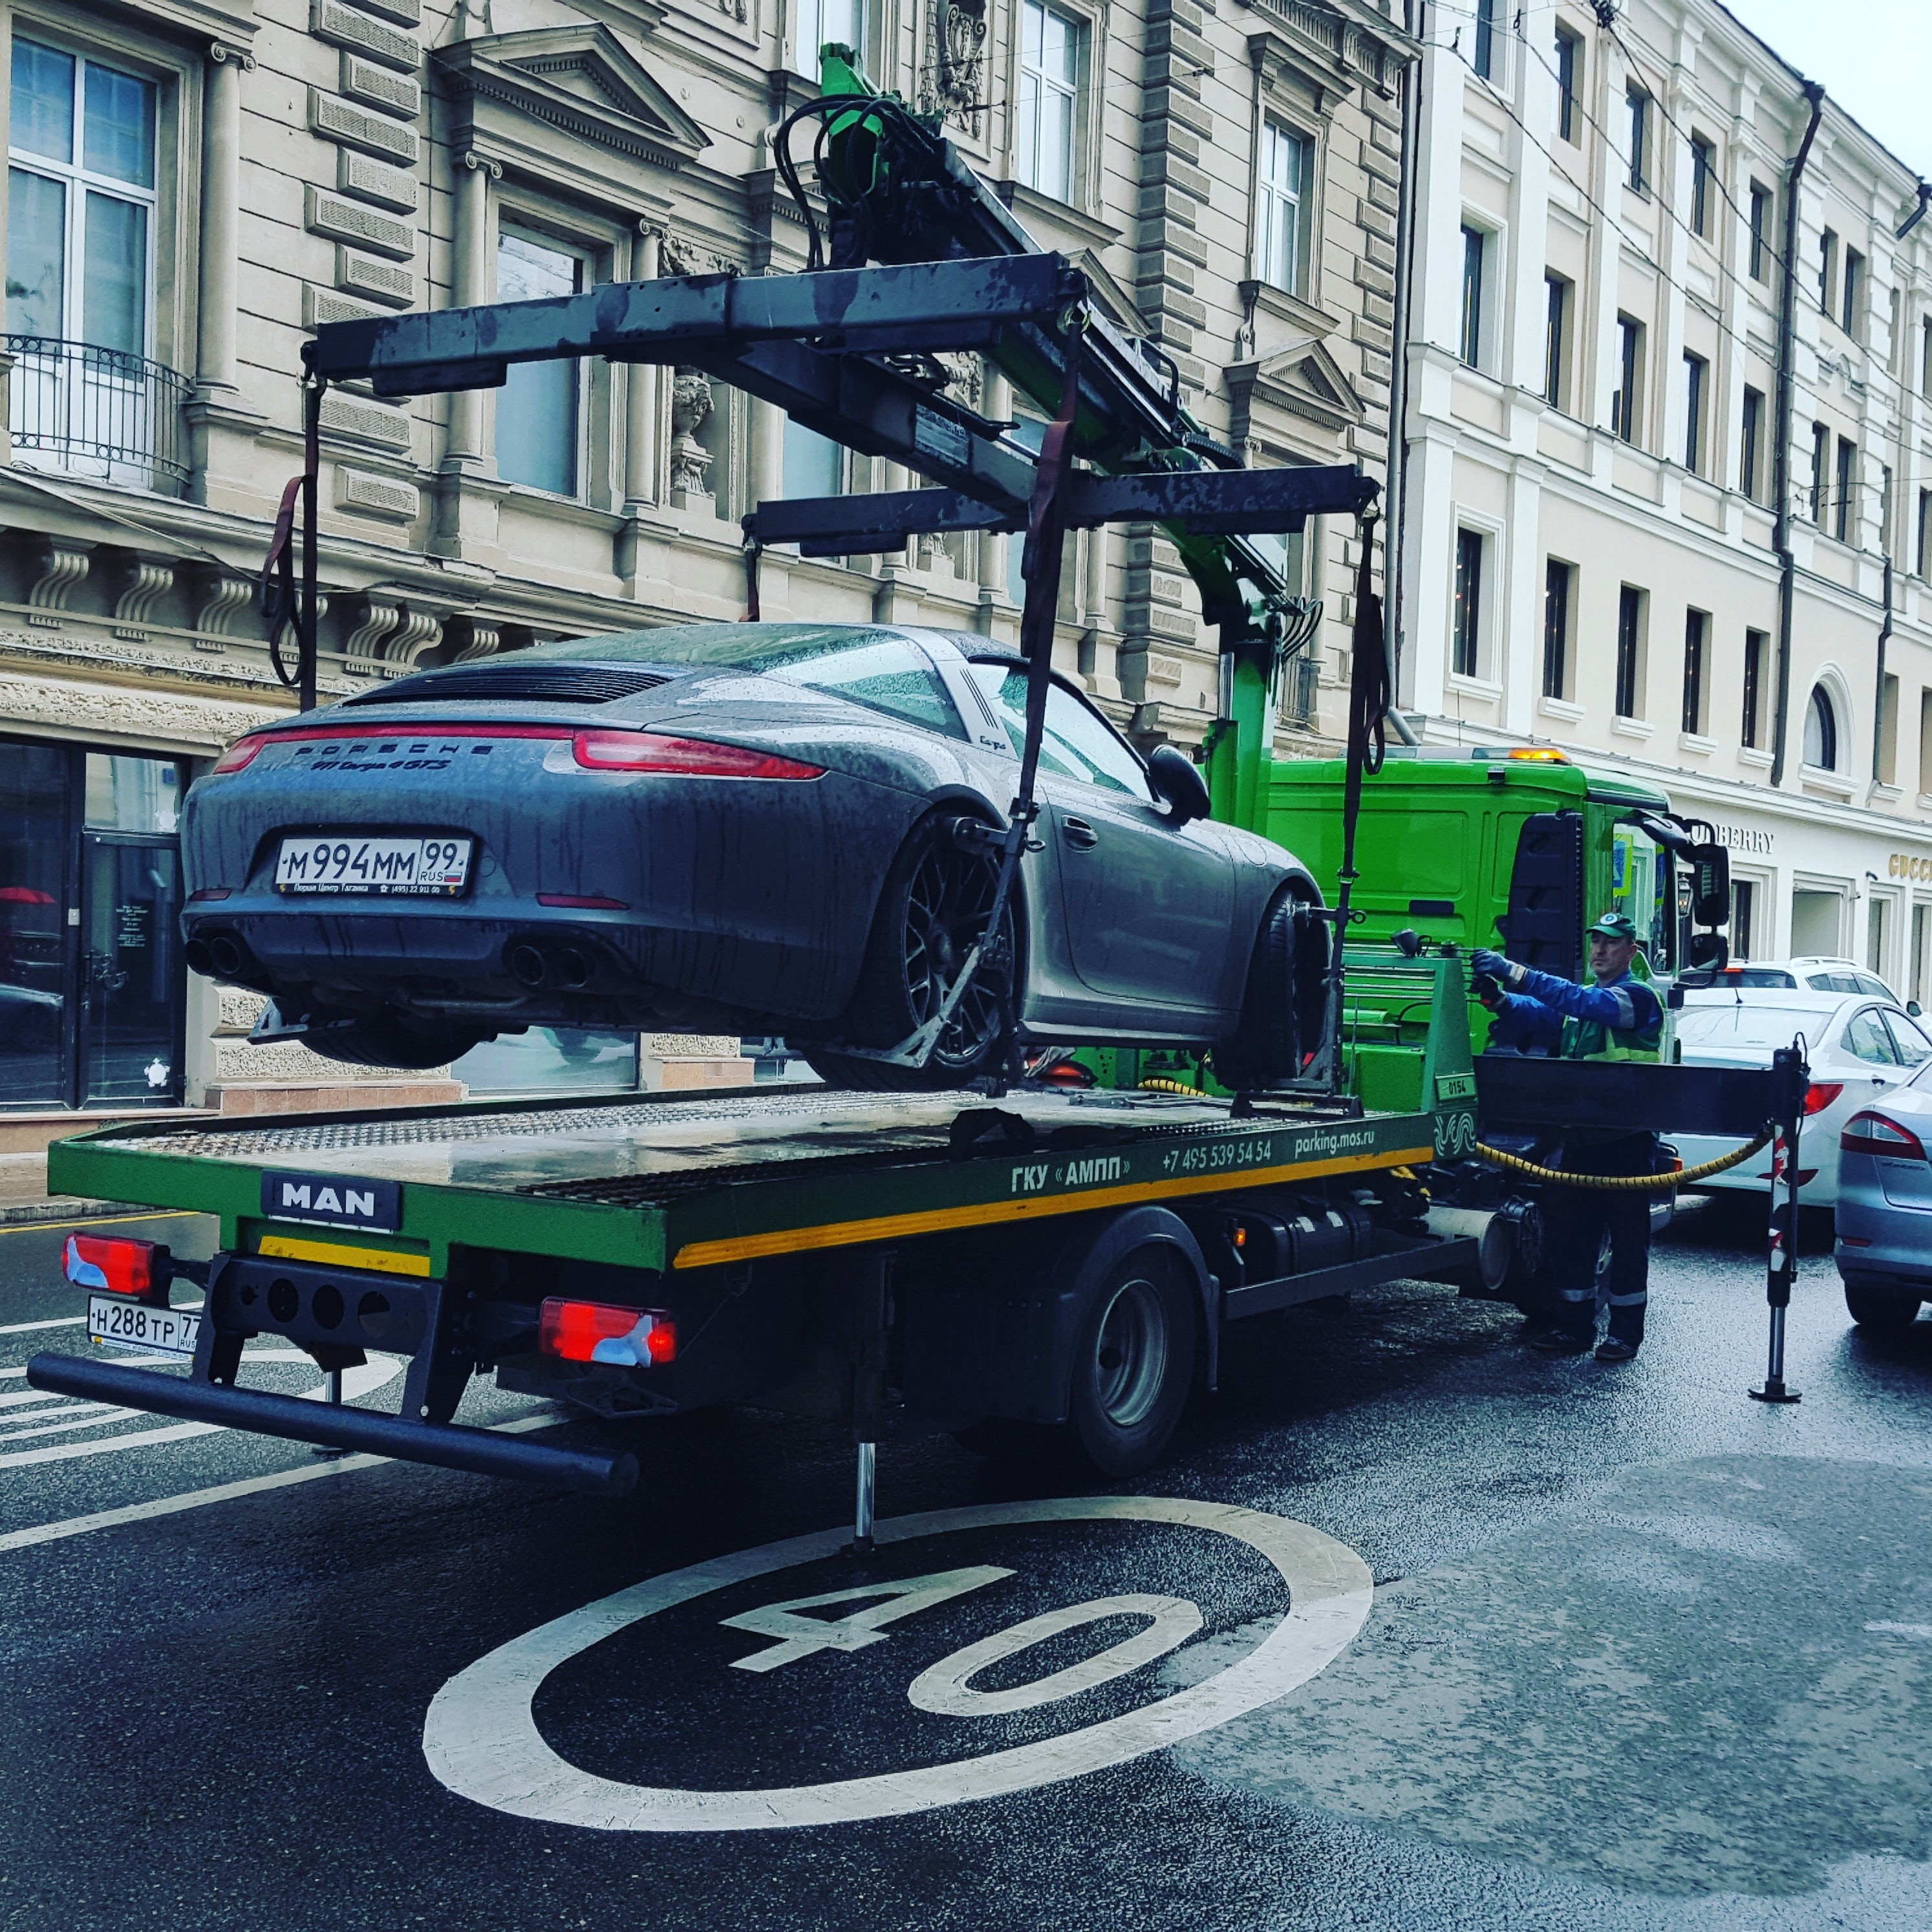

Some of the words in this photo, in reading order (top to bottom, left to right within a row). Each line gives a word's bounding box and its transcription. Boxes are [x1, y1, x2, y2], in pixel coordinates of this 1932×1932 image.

[295, 744, 493, 755] PORSCHE
[310, 761, 340, 771] 911
[287, 843, 416, 879] М994ММ
[425, 843, 457, 870] 99
[420, 871, 444, 881] RUS
[1448, 1080, 1466, 1095] 0154
[1163, 1150, 1179, 1173] +7
[1182, 1146, 1207, 1170] 495
[1210, 1144, 1234, 1167] 539
[1236, 1141, 1253, 1164] 54
[1255, 1139, 1272, 1162] 54
[1294, 1129, 1375, 1159] parking.mos.ru
[1011, 1164, 1049, 1193] ГКУ
[1055, 1156, 1130, 1186] «АМПП»
[283, 1183, 374, 1217] MAN
[180, 1339, 197, 1349] RUS
[718, 1564, 1204, 1717] 40
